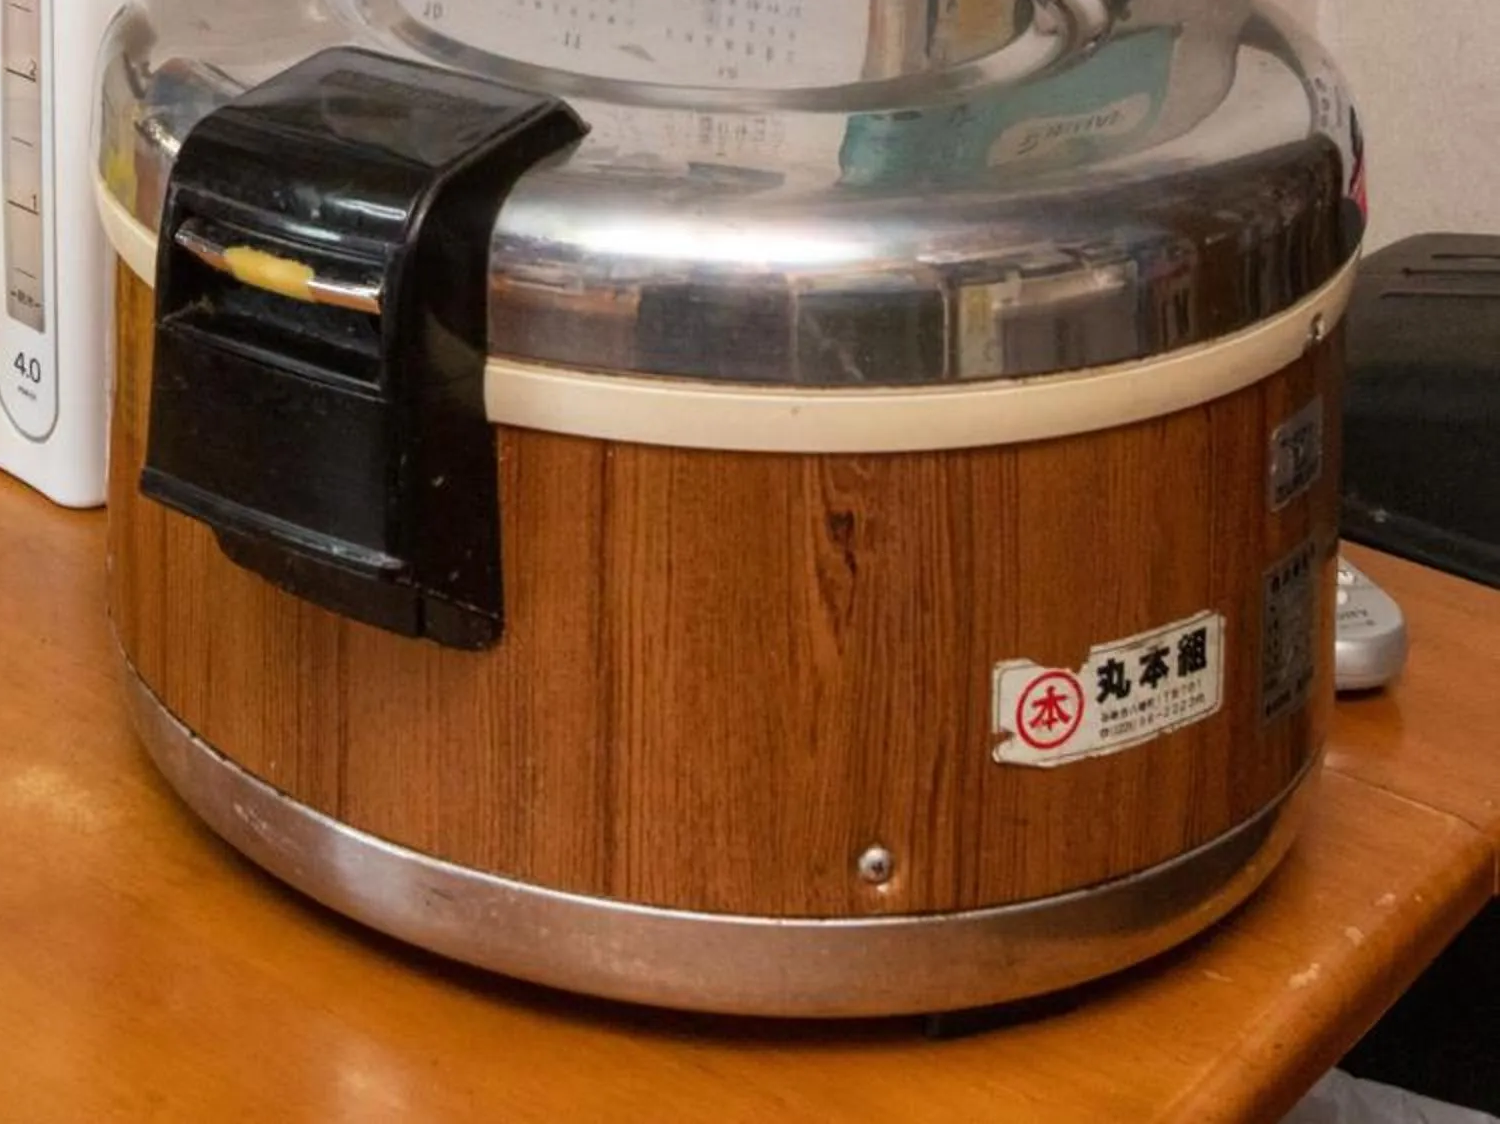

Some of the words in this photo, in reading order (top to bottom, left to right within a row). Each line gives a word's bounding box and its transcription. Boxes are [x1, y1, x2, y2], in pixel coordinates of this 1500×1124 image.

[13, 351, 42, 384] 4.0
[1096, 626, 1208, 704] 丸本組
[1029, 684, 1071, 731] 本
